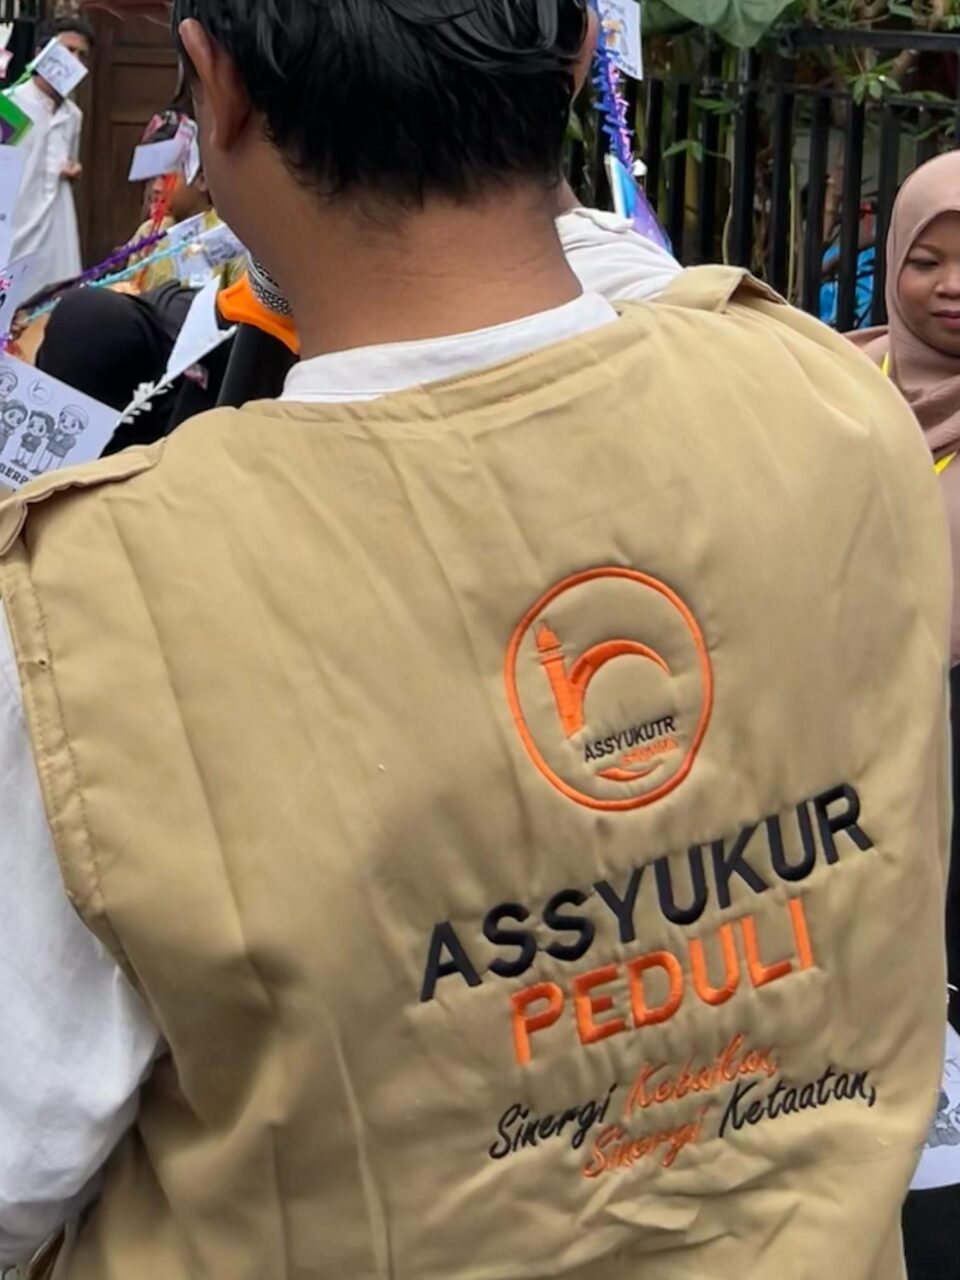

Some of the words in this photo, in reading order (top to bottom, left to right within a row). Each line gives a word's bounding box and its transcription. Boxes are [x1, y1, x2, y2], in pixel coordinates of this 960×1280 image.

[419, 782, 875, 1004] ASSYUKUR
[510, 897, 813, 1065] PEDULI
[488, 1082, 619, 1160] Sinergi
[717, 1063, 878, 1139] Ketaatan,
